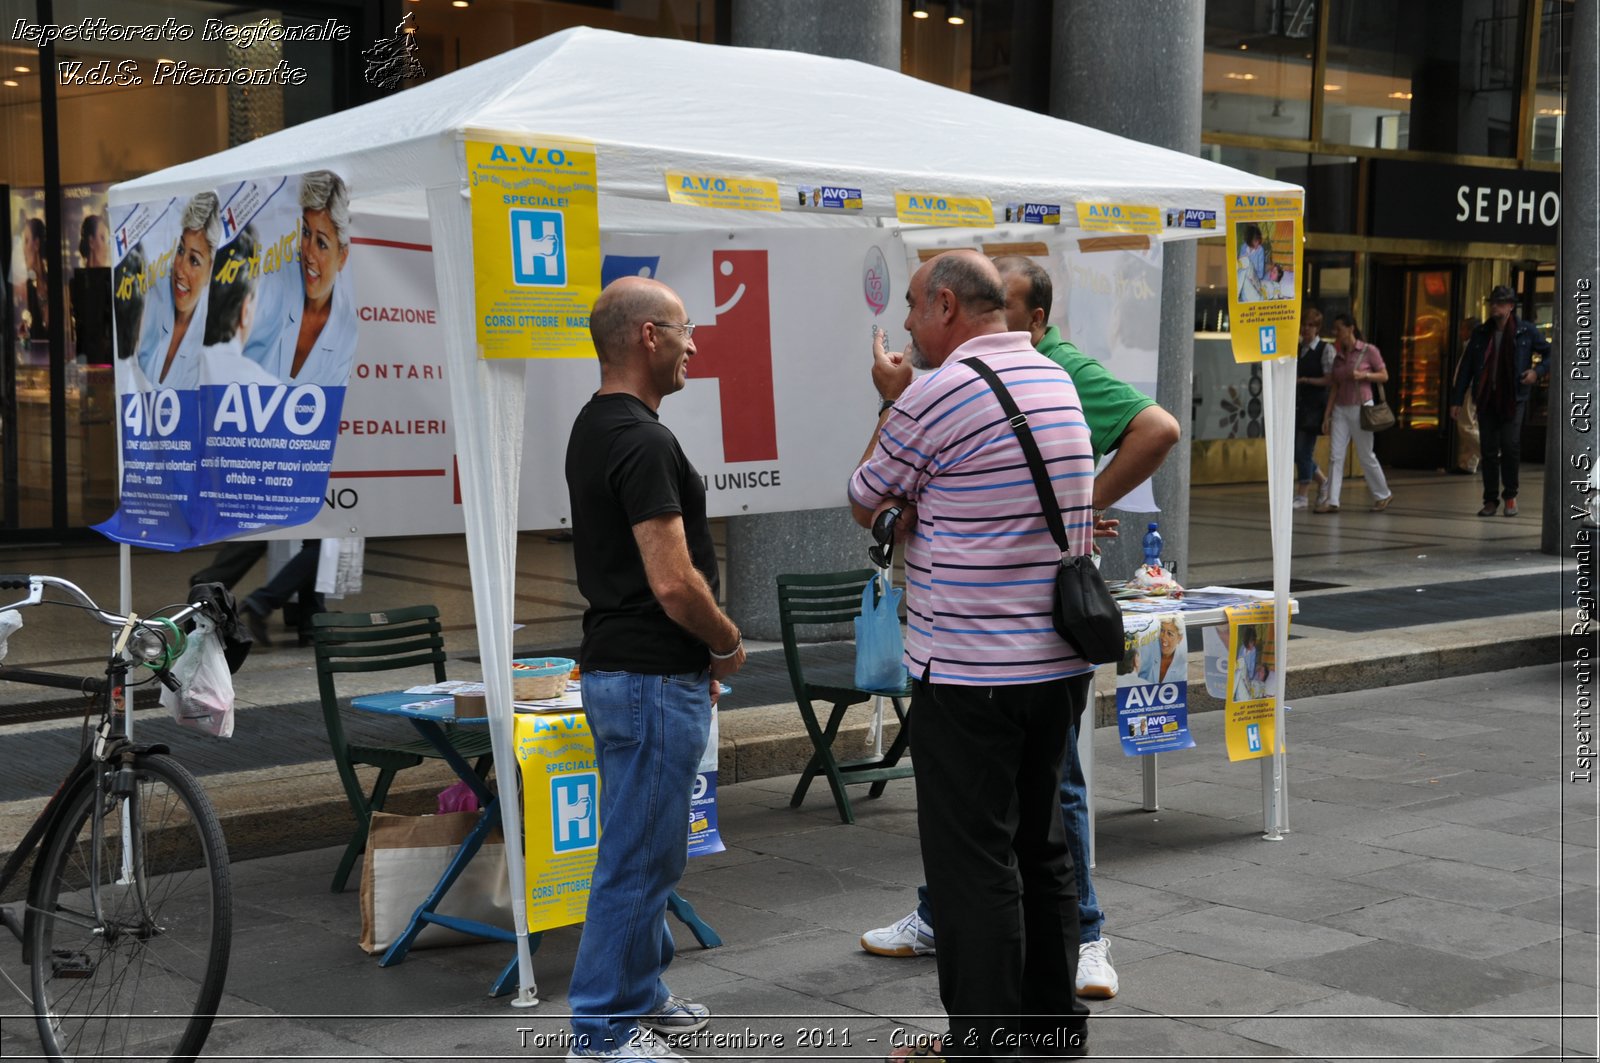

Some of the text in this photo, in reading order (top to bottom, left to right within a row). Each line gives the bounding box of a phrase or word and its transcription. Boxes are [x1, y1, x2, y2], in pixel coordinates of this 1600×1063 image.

[490, 145, 573, 167] A.V.O.
[681, 176, 731, 193] A.V.O.
[503, 194, 569, 207] SPECIALE!
[822, 187, 849, 200] AVO
[909, 196, 951, 212] A.V.O.
[1235, 196, 1270, 207] A.V.O.
[1025, 204, 1048, 216] AVO
[1089, 205, 1125, 218] A.V.O.
[1186, 209, 1206, 220] AVO
[215, 250, 241, 285] io
[485, 315, 515, 327] CORSI
[518, 315, 559, 328] OTTOBRE
[213, 381, 327, 436] AVO
[247, 438, 287, 449] VOLONTARI
[289, 440, 331, 450] OSPEDALIERI
[220, 457, 260, 470] formazione
[262, 461, 276, 473] per
[278, 460, 301, 472] nuovi
[226, 472, 256, 485] ottobre
[265, 477, 293, 487] marzo
[715, 470, 781, 491] UNISCE
[1125, 683, 1179, 709] AVO
[1148, 715, 1166, 726] AVO
[532, 878, 591, 899] CORSI OTTOBRE
